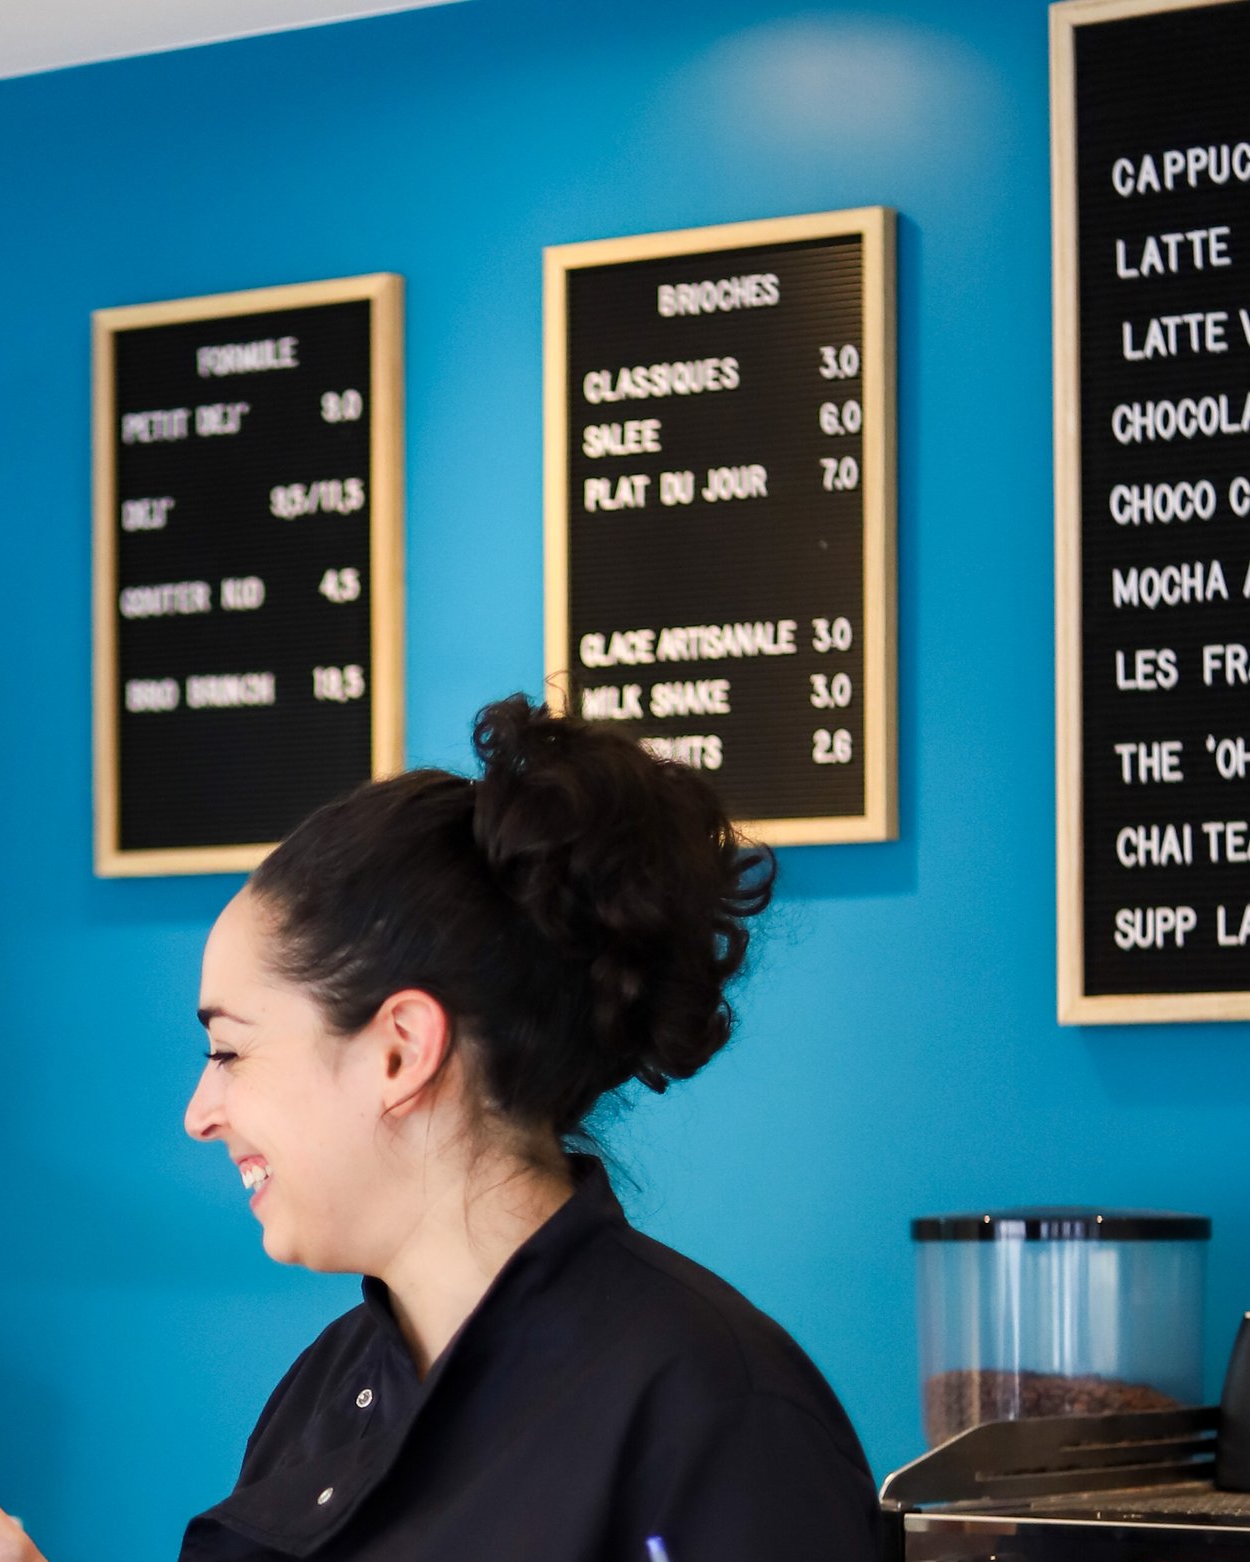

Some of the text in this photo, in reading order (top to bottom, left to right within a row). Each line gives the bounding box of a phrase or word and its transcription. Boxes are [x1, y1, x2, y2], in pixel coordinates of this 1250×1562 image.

[1116, 226, 1232, 279] LATTE
[657, 273, 780, 317] BRIOCHES
[1122, 311, 1228, 361] LATTE
[583, 356, 740, 404] CLASSIQUES
[582, 399, 863, 459] SALEE 6.0
[584, 455, 859, 512] PLAT DU JOUR 7.0
[1109, 480, 1217, 525] CHOCO
[1112, 560, 1229, 609] MOCHA
[579, 629, 656, 668] GLACE
[656, 619, 797, 662] ARTISANALE
[1115, 643, 1250, 690] LES FR
[581, 684, 644, 721] MILK
[649, 679, 731, 718] SHAKE
[1114, 741, 1184, 784] THE
[1116, 821, 1250, 867] CHAI TE
[1114, 906, 1197, 949] SUPP
